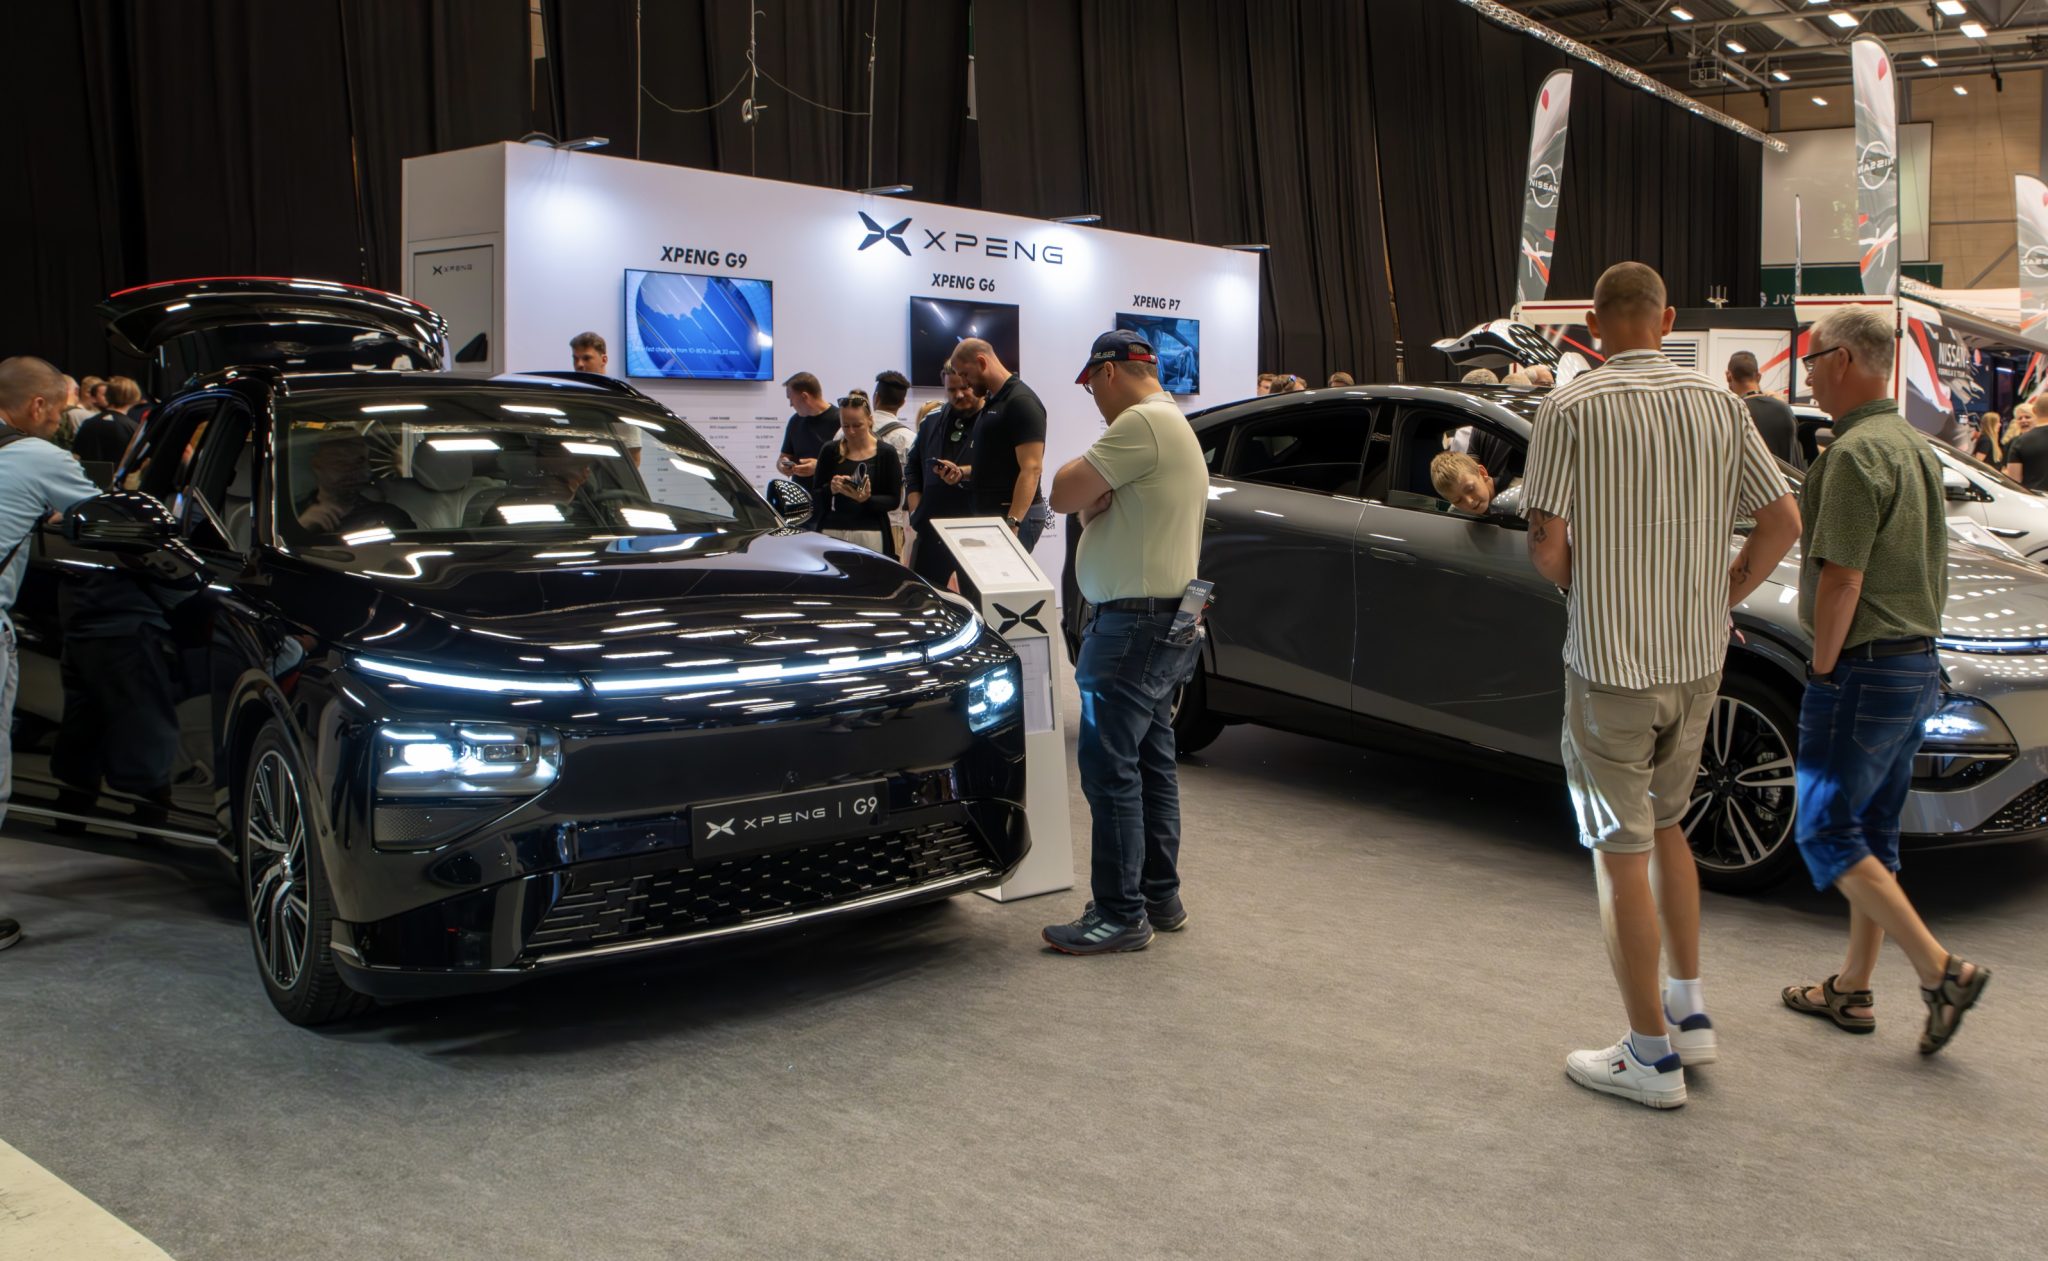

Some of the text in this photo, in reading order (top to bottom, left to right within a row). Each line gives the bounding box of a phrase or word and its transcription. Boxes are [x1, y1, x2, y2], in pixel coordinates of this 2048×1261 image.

[1529, 178, 1559, 194] NISSAN
[661, 246, 748, 268] XPENG G9
[923, 228, 1063, 265] XPENG
[931, 273, 996, 292] XPENG G6
[1132, 294, 1181, 311] XPENG P7
[1938, 342, 1966, 367] NISSAN
[744, 797, 877, 830] XPENG G9
